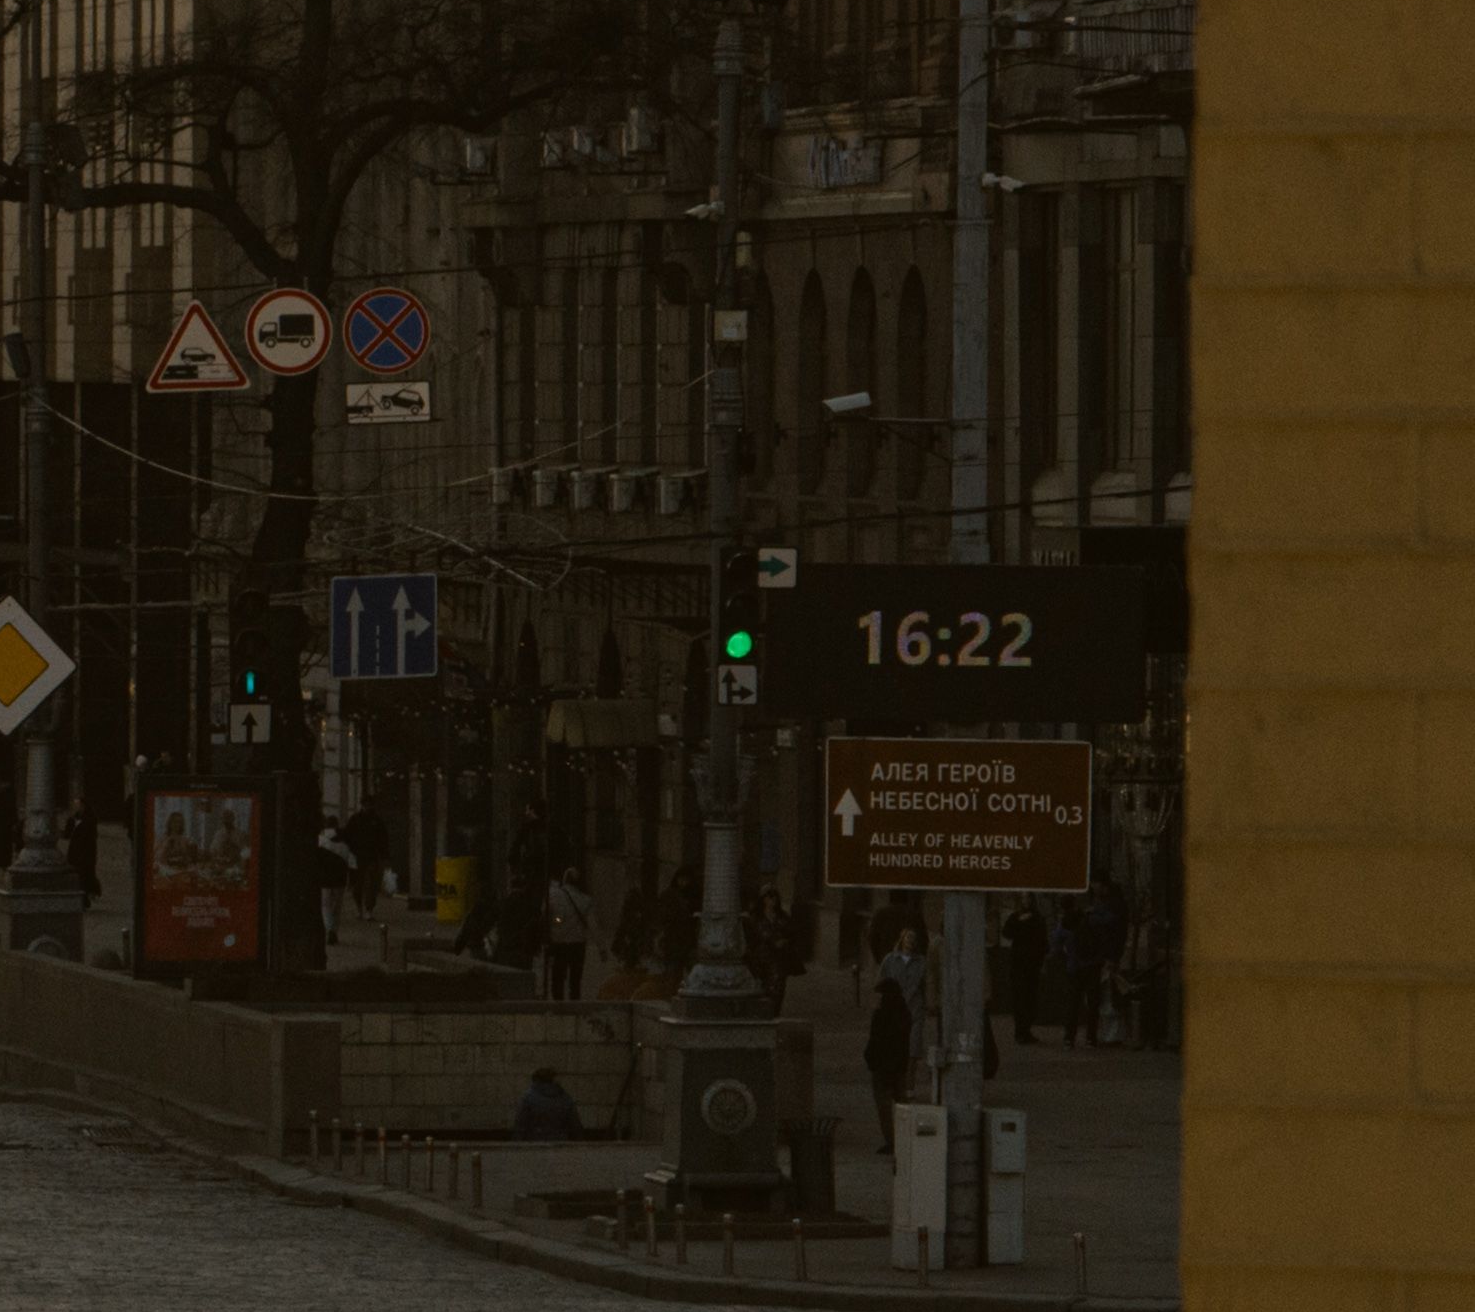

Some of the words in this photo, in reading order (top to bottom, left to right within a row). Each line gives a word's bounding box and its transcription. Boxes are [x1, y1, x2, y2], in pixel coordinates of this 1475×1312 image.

[857, 610, 1034, 667] 16:22
[870, 762, 929, 783] АЛЕЯ
[937, 759, 1016, 784] ГЕРОЇВ
[869, 787, 981, 812] НЕБЕСНОЇ
[987, 791, 1051, 813] СОТНІ
[1054, 806, 1083, 826] 0,3
[869, 833, 919, 848] ALLEY
[924, 833, 946, 849] OF
[950, 834, 1034, 850] HEAVENLY
[869, 853, 943, 870] HUNDRED
[948, 855, 1012, 871] HEROES
